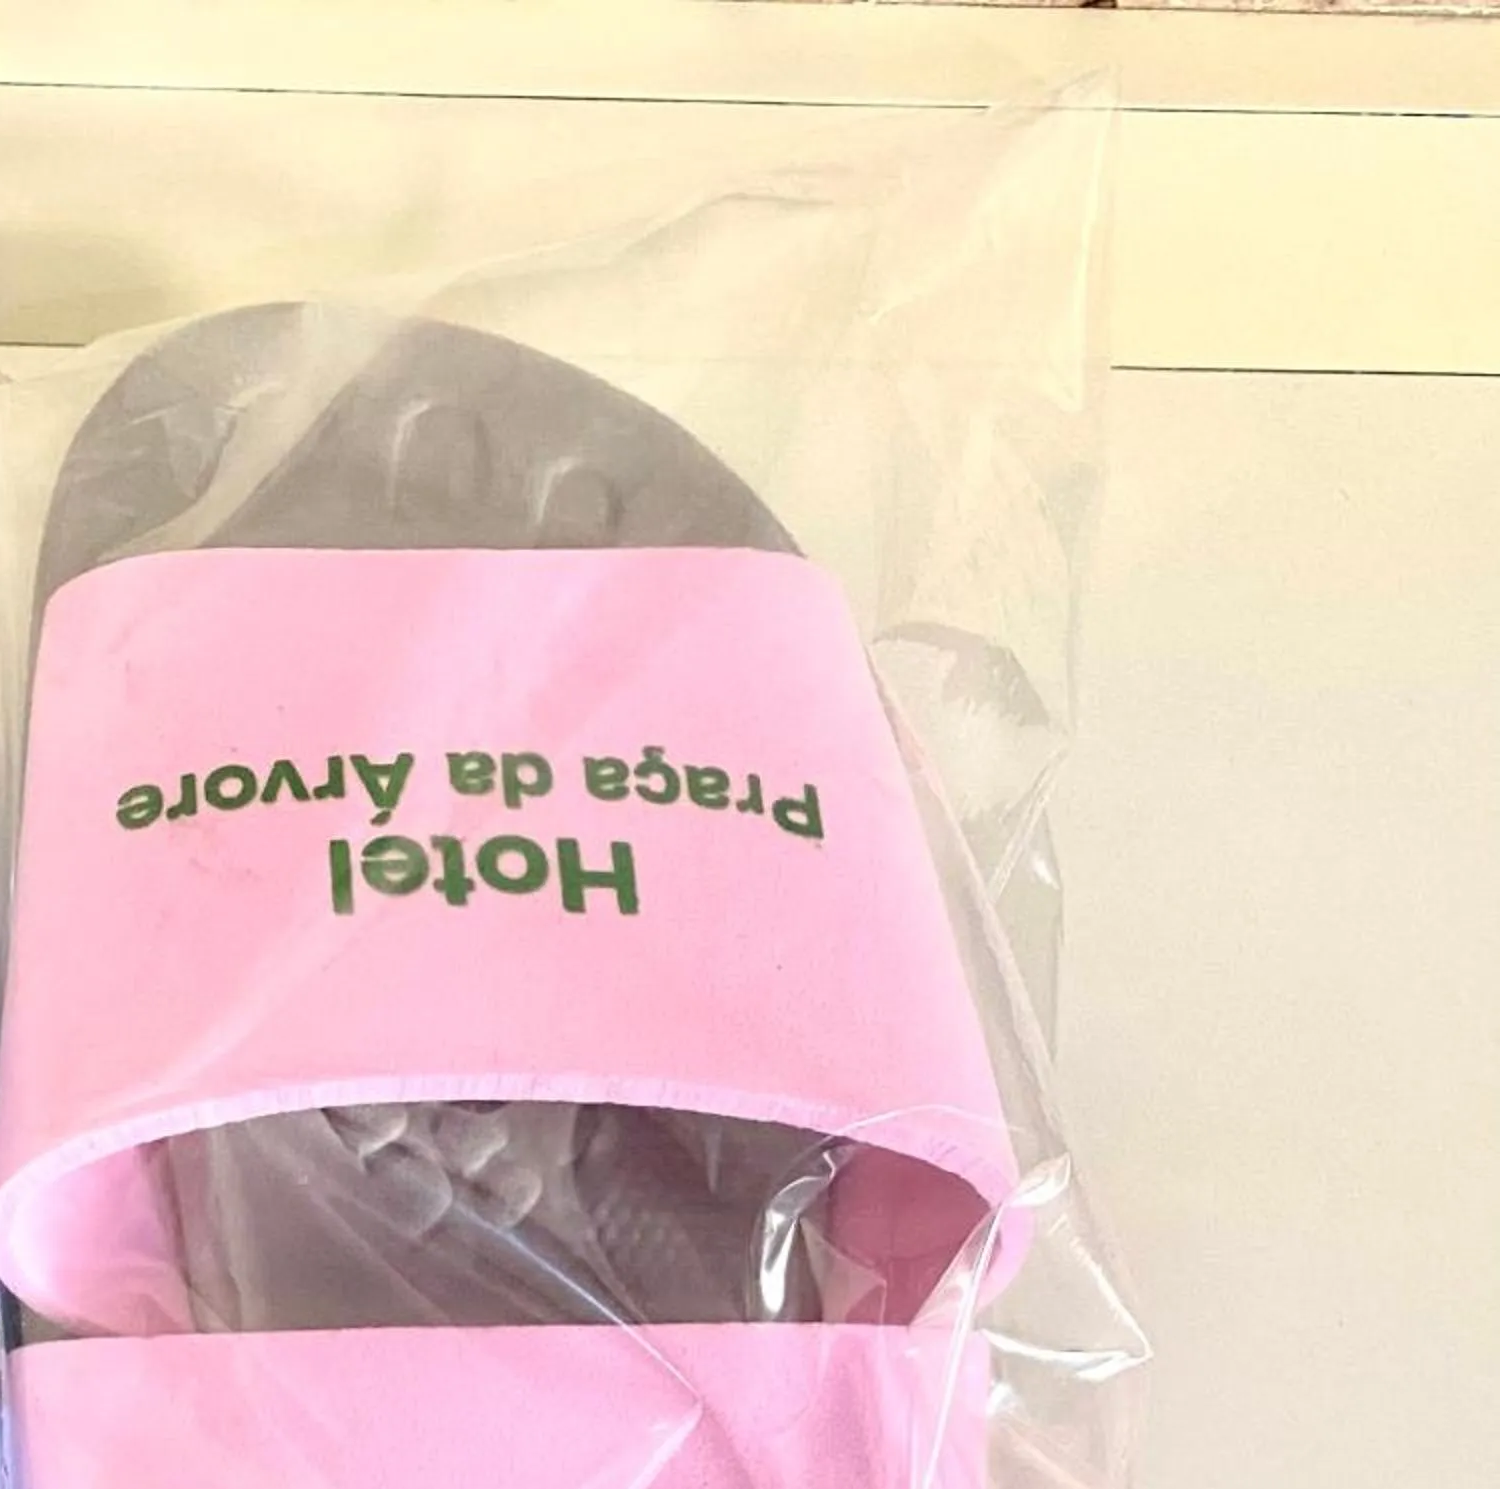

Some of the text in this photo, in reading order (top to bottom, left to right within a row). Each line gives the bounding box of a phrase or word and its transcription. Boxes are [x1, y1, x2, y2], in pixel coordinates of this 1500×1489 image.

[115, 746, 825, 840] Praça da Árvore
[328, 833, 641, 915] Hotel
